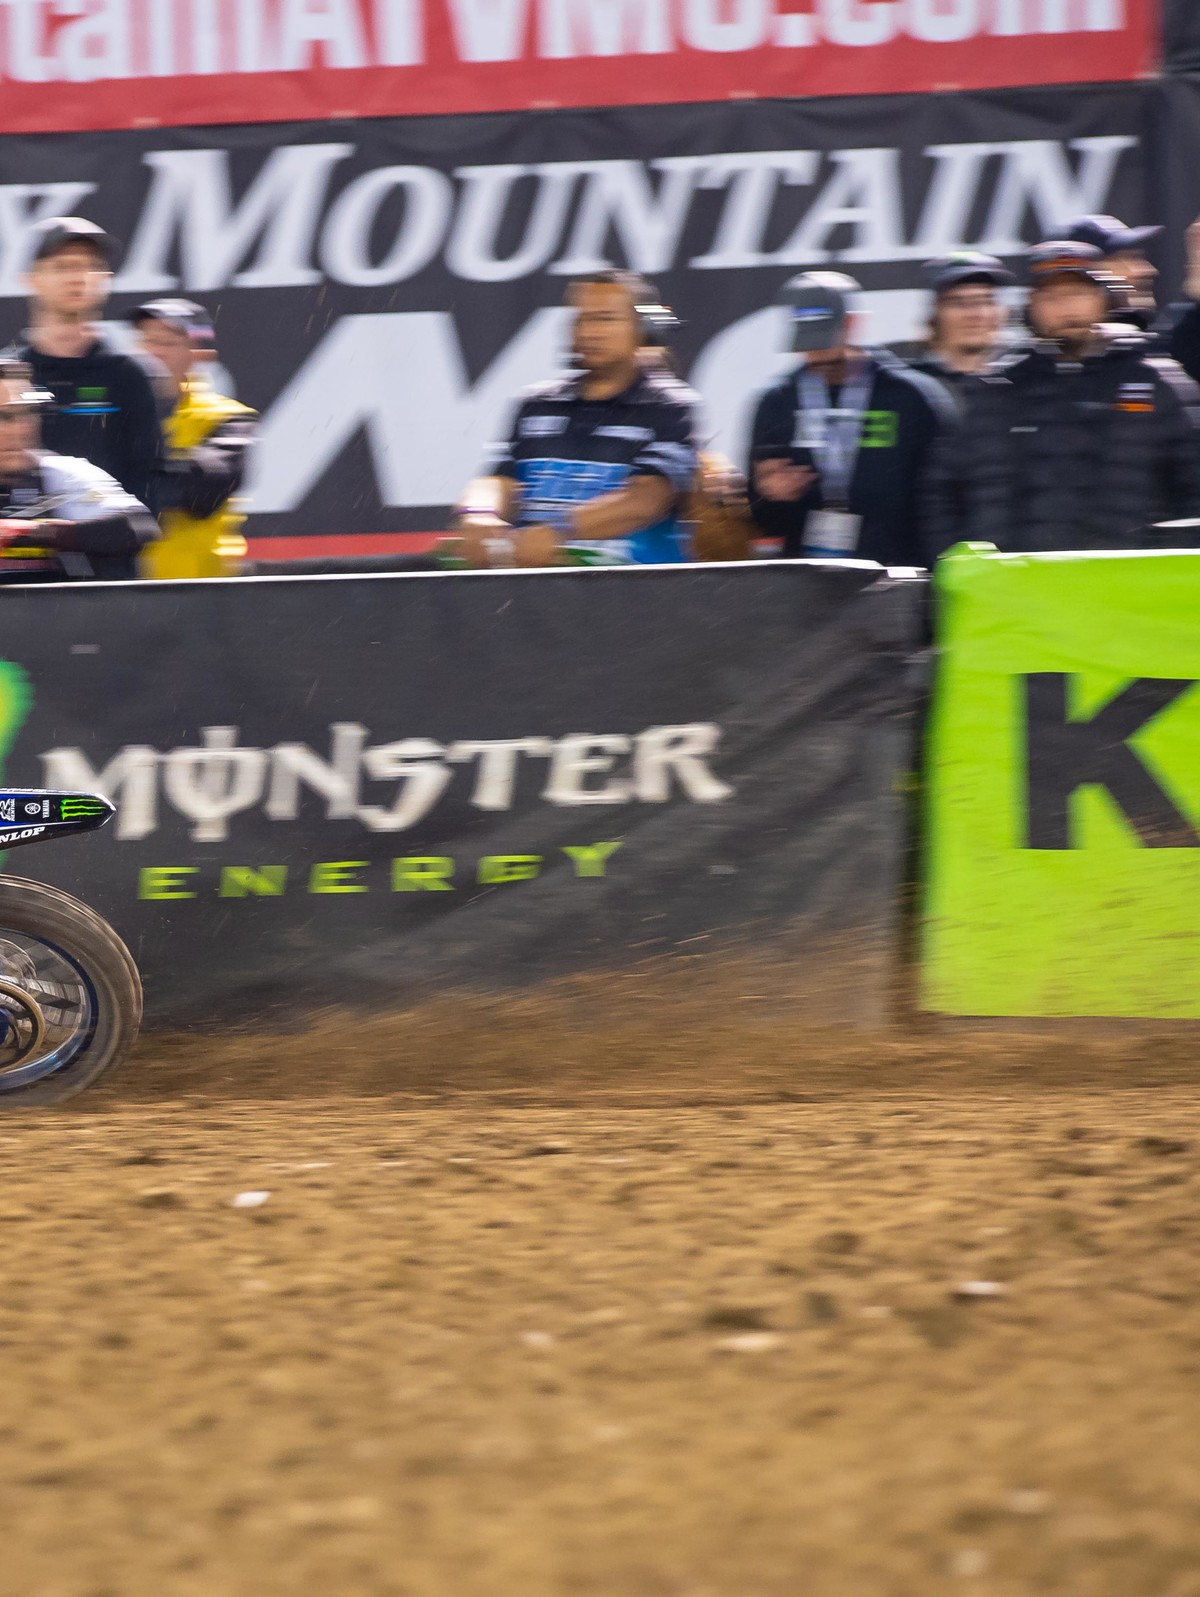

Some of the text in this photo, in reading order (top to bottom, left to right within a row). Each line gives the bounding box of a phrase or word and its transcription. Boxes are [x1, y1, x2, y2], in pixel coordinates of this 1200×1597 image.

[120, 134, 1141, 293] MOUNTAIN
[37, 721, 734, 842] MONSTER
[137, 842, 624, 900] ENERGY
